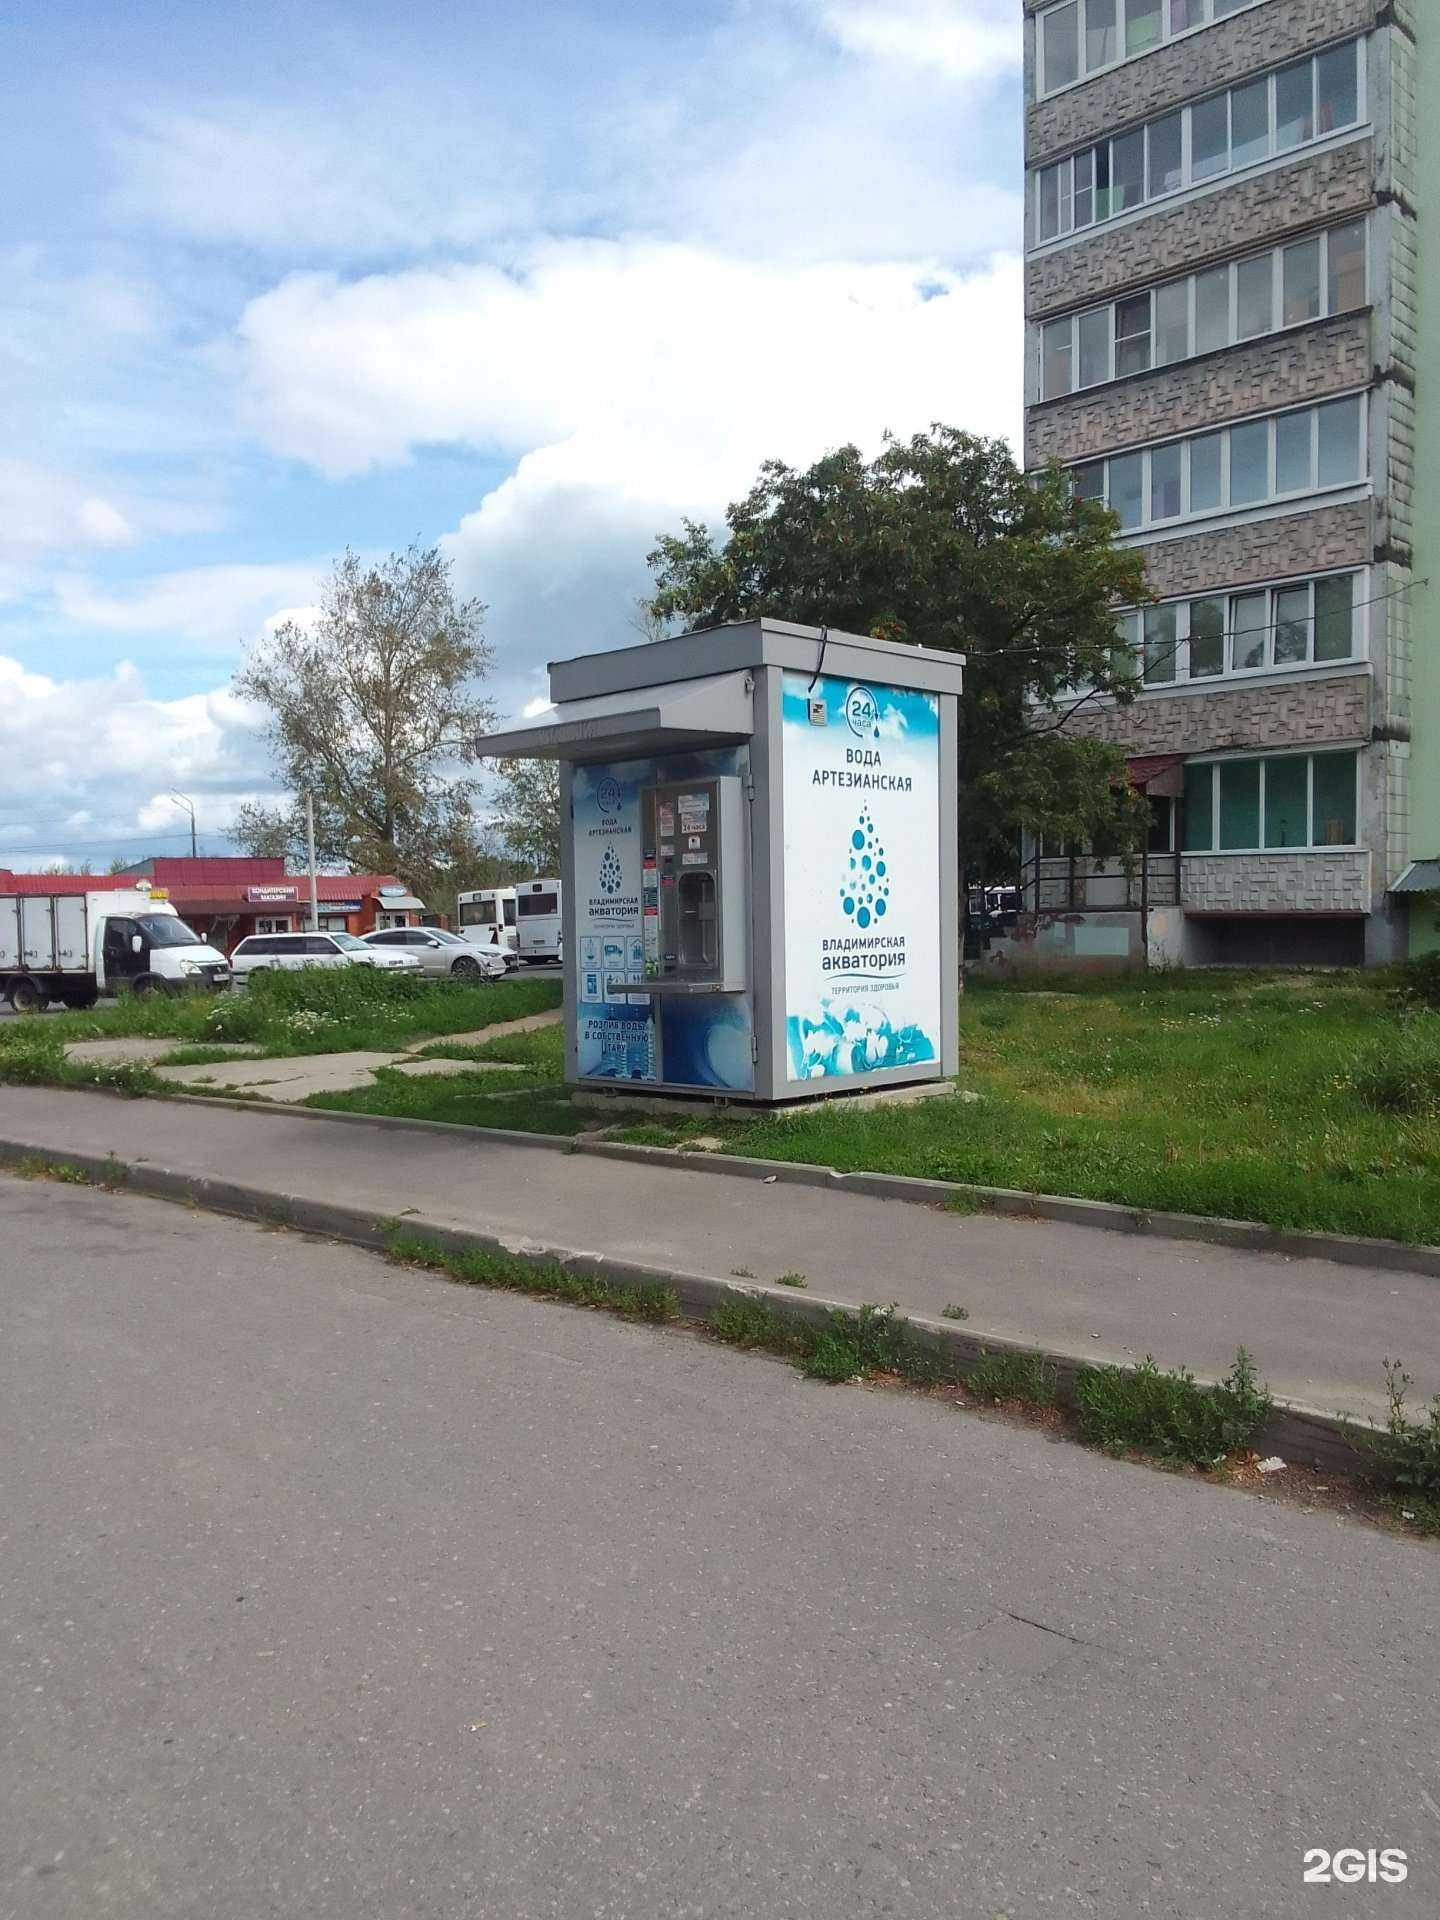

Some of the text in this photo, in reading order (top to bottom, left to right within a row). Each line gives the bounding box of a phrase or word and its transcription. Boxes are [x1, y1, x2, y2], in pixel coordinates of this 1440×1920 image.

[852, 700, 872, 719] 24
[852, 719, 872, 728] часа
[846, 748, 882, 767] ВОДА
[812, 769, 912, 792] АРТЕЗИАНСКАЯ
[588, 897, 639, 906] ВЛАДИМИРСКАЯ
[588, 906, 639, 917] акватория
[822, 935, 906, 953] ВЛАДИМИРСКАЯ
[821, 952, 906, 971] акватория
[831, 984, 869, 995] ТЕРРИТОРИЯ
[588, 1019, 646, 1031] РОЗЛИВ ВОДЫ
[585, 1031, 590, 1040] В
